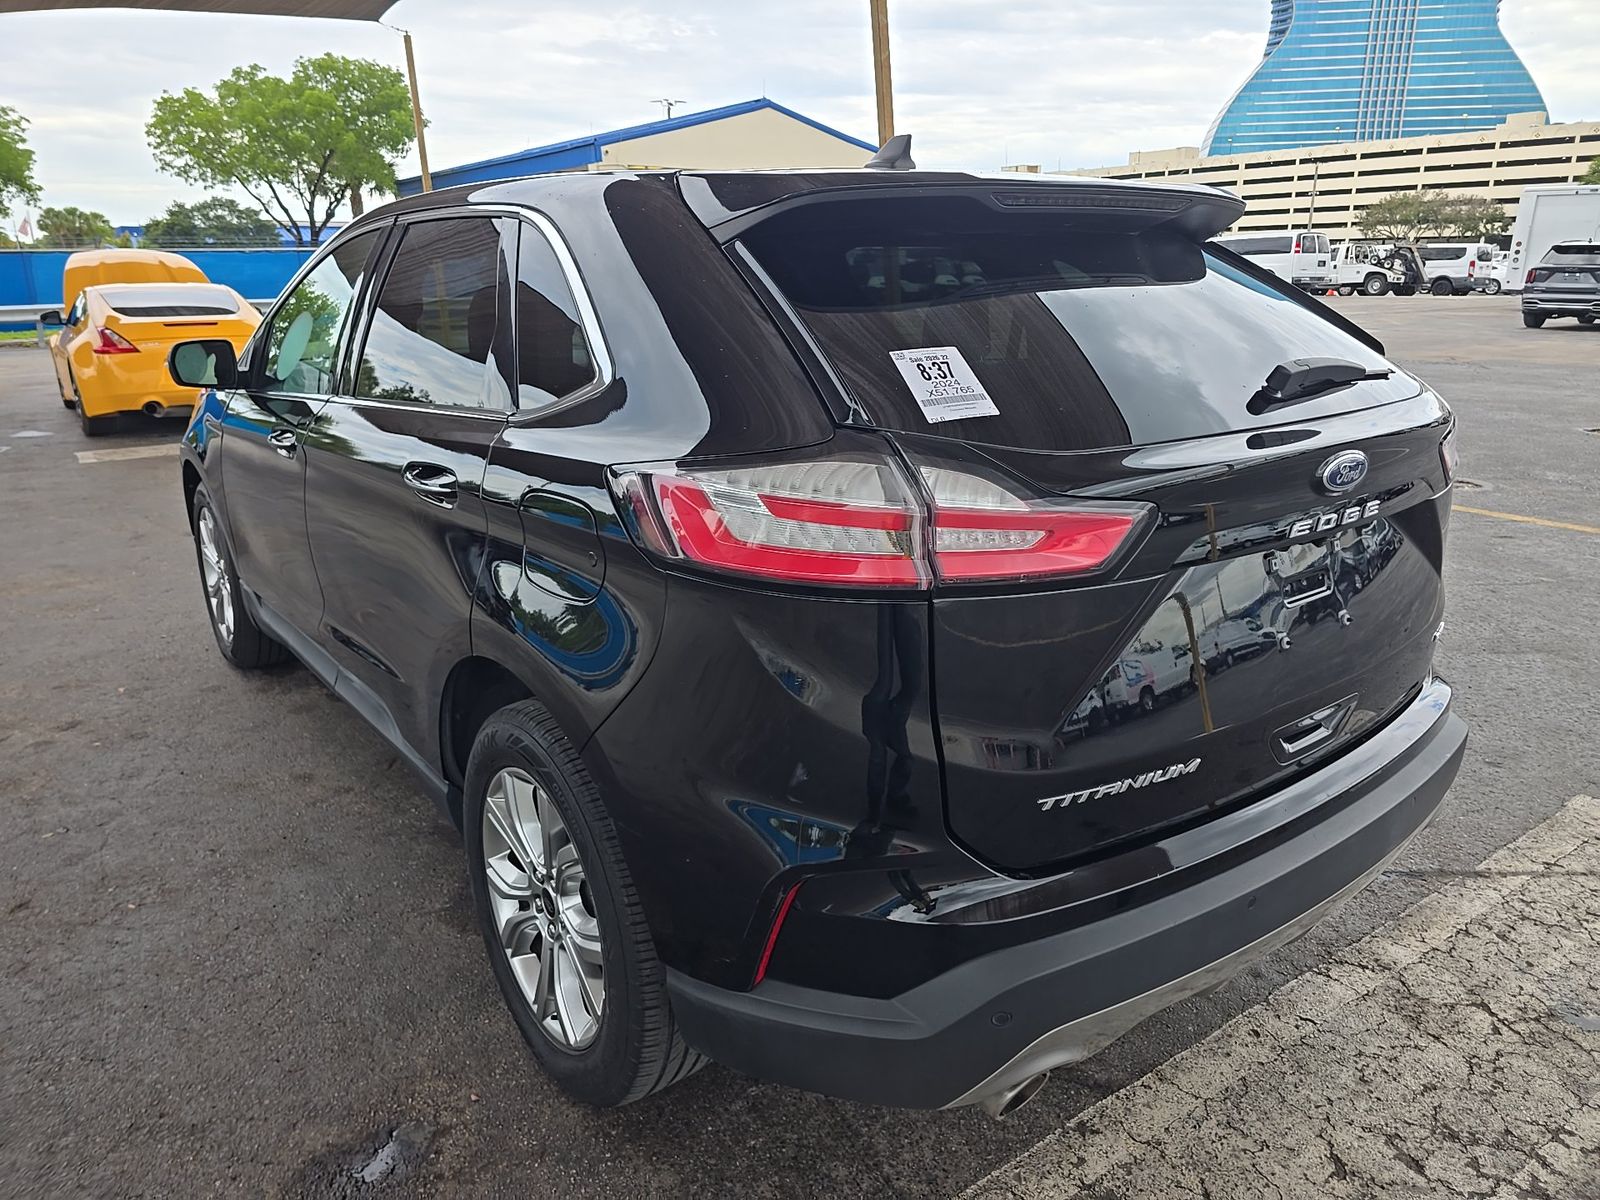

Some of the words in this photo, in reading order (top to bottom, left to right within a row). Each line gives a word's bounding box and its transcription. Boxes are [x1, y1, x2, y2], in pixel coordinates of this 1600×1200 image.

[916, 361, 955, 381] 8:37
[931, 379, 961, 389] 2024
[1289, 500, 1381, 538] EDGE
[1037, 758, 1201, 811] TITANIUM
